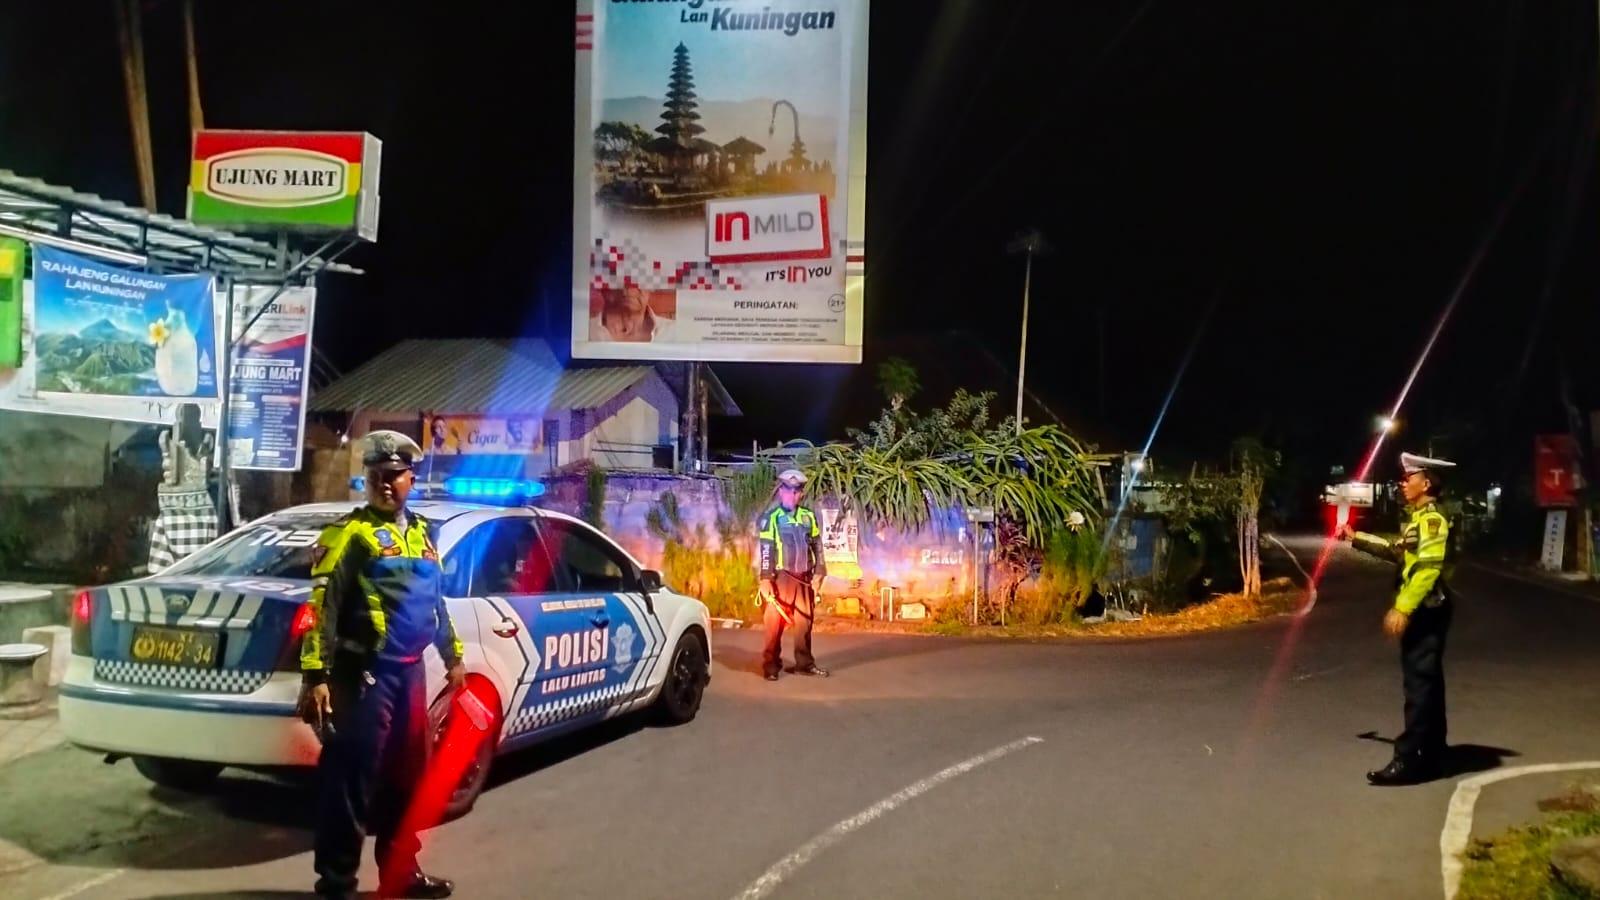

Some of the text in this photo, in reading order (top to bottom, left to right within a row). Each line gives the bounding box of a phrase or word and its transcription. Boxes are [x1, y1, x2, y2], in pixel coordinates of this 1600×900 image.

[680, 7, 835, 36] Lan Kuningan
[215, 168, 337, 187] UJUNG MART
[754, 211, 814, 235] MILD
[41, 260, 167, 290] RAHAJENG GALUNGAN
[765, 270, 786, 283] IT'S
[808, 266, 832, 280] YOU
[91, 282, 146, 301] KUNINGAN
[734, 300, 799, 310] PERINGATAN:
[268, 366, 303, 382] MART
[762, 543, 771, 570] POLISI
[544, 628, 610, 671] POLISI
[541, 676, 571, 694] LALU
